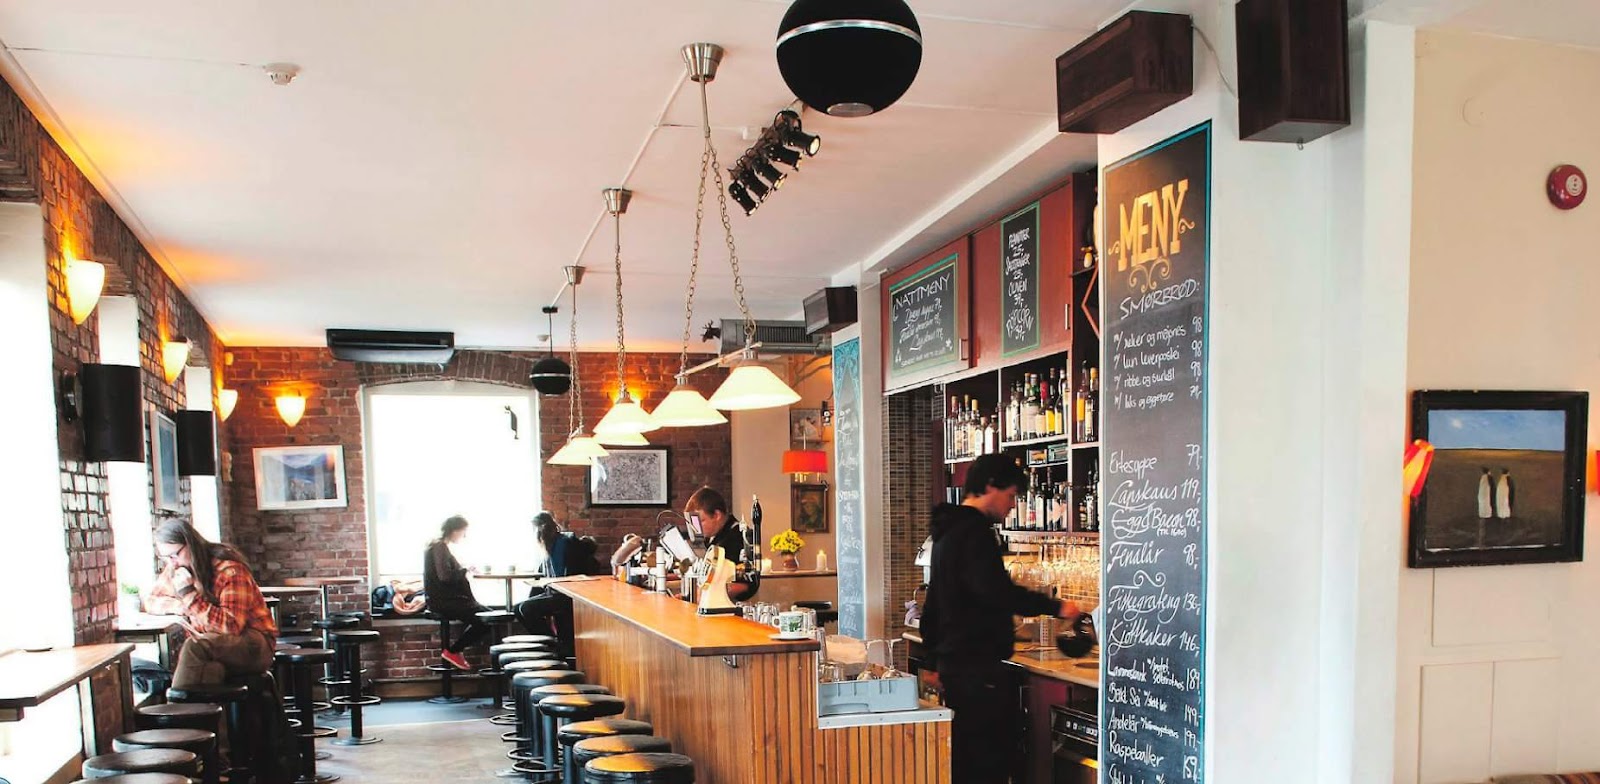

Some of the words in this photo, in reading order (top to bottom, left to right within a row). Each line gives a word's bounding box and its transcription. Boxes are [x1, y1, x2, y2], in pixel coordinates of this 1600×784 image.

[1117, 178, 1190, 272] MENY
[895, 272, 951, 310] NATTMENY
[1146, 333, 1156, 347] og
[1156, 325, 1187, 346] majones
[1123, 353, 1139, 369] lun
[1140, 345, 1180, 368] leverpostei
[1142, 375, 1151, 387] og
[1109, 450, 1158, 481] Ertesuppe
[1108, 479, 1177, 511] Lapskaus
